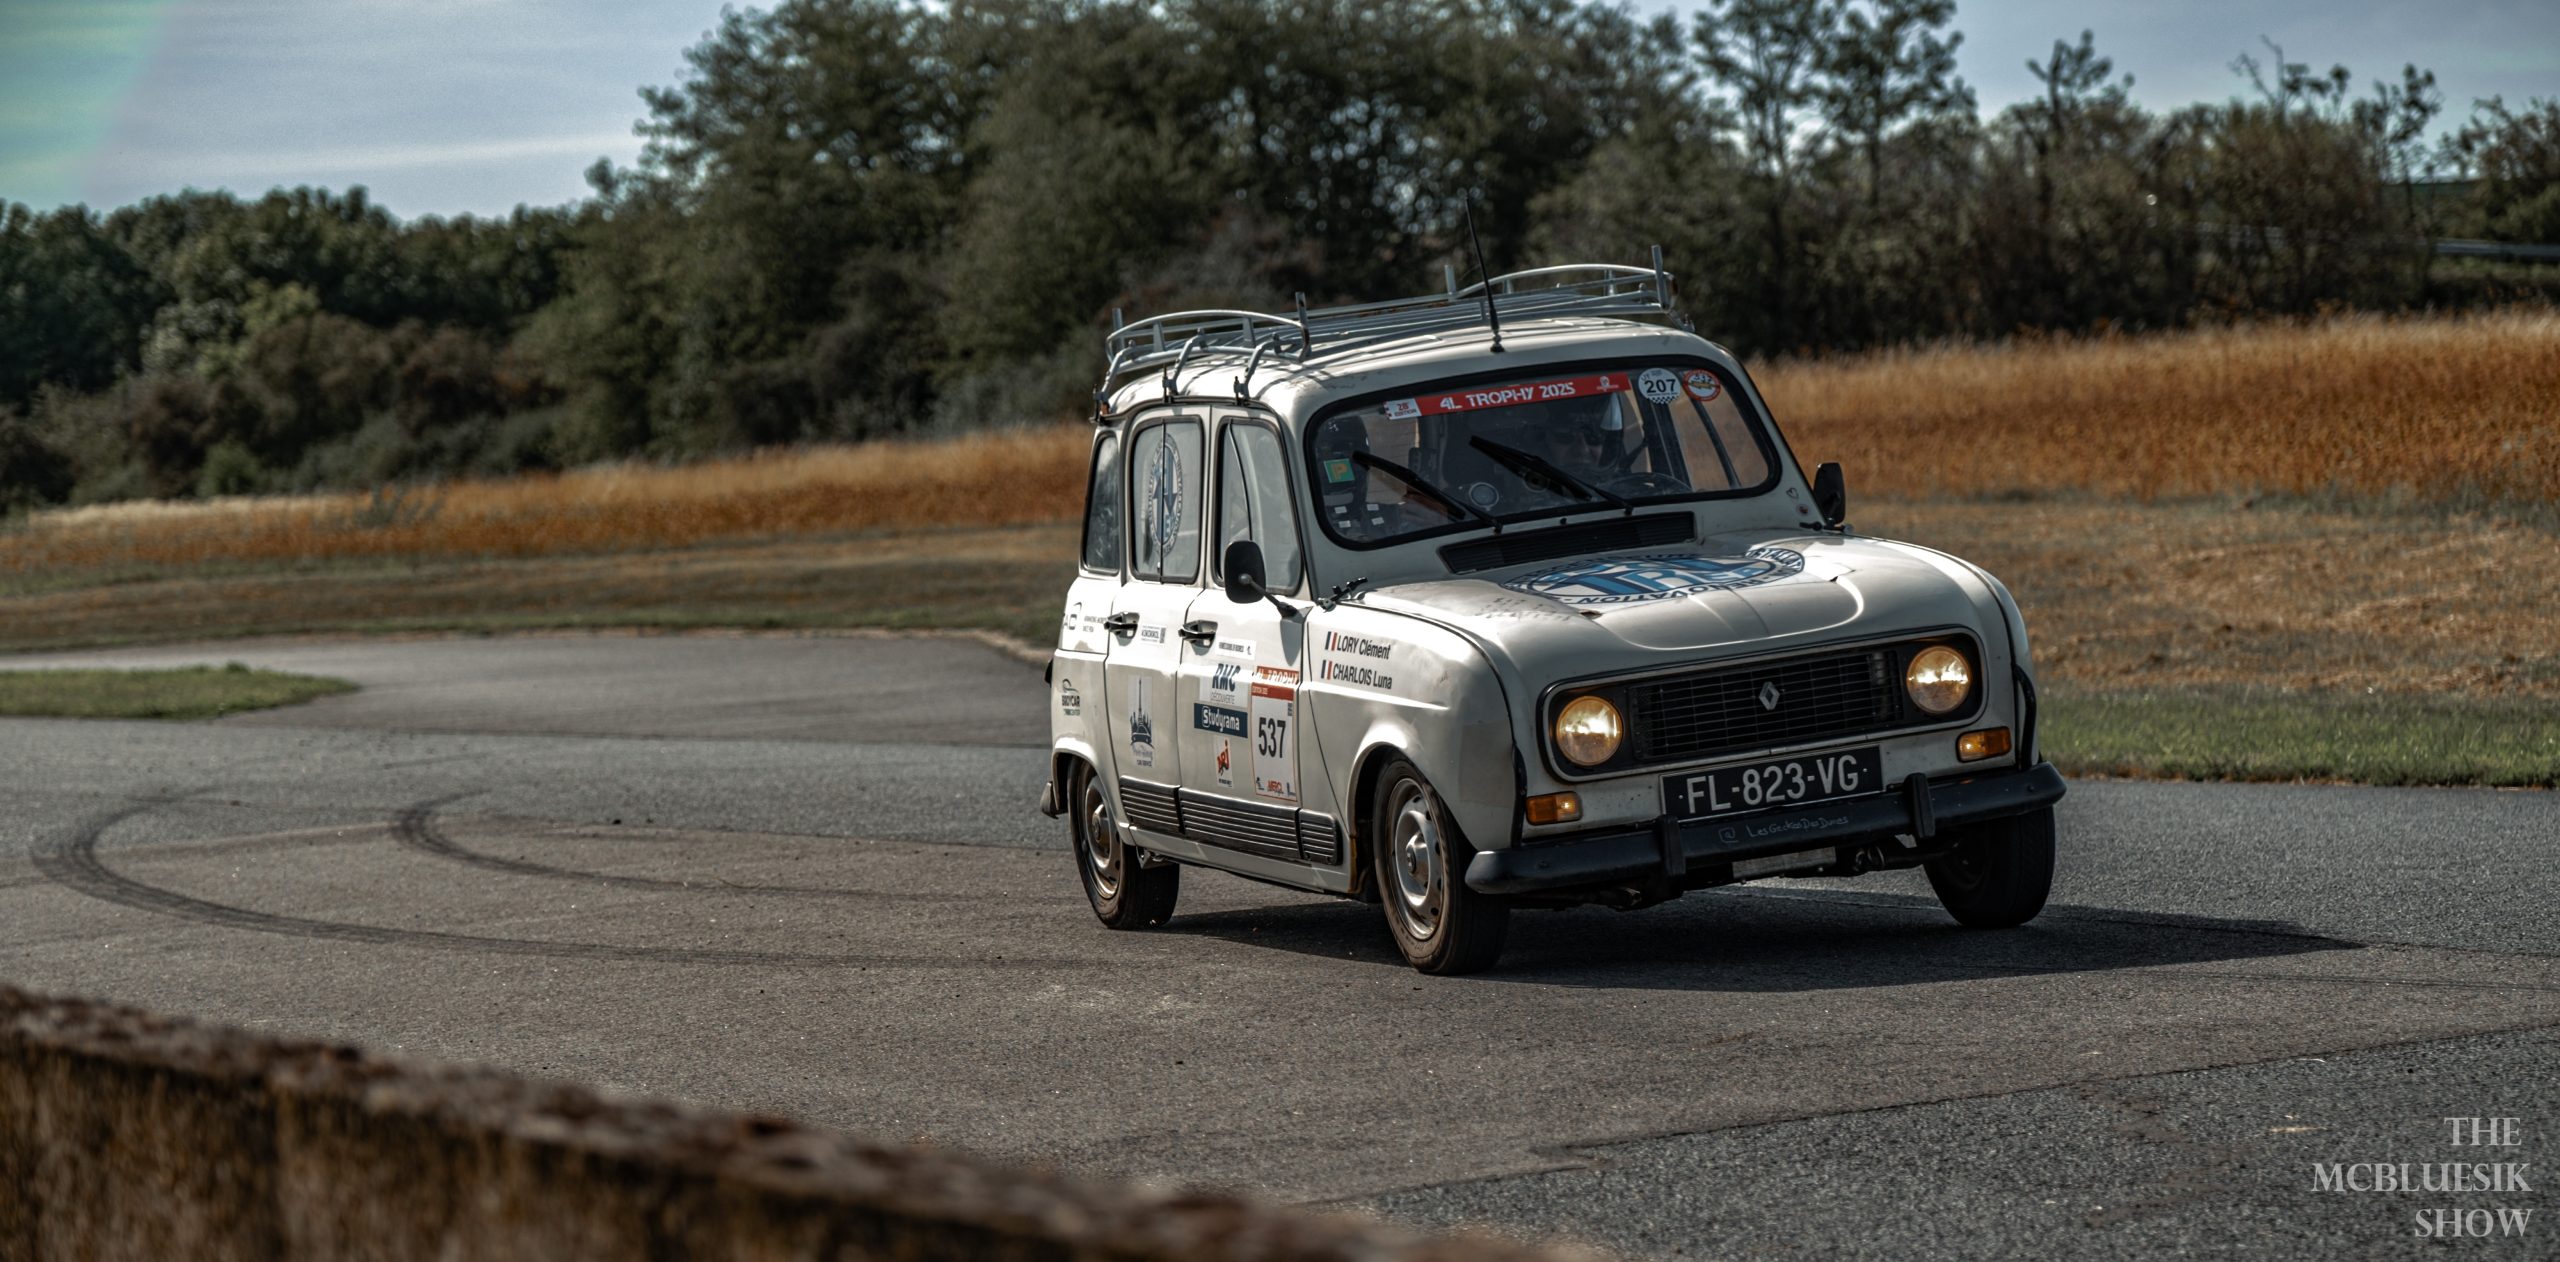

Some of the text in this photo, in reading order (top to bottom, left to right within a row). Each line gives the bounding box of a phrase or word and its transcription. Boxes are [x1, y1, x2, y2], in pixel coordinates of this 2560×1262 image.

[1440, 396, 1463, 410] 4L
[1465, 386, 1534, 408] TROPHY
[1539, 381, 1577, 399] 2025
[1644, 378, 1677, 394] 207
[1336, 634, 1391, 661] LORY Clément
[1211, 662, 1241, 693] RMC
[1332, 662, 1393, 690] CHARLOIS Luna
[1202, 705, 1240, 733] Studyrama
[1258, 716, 1287, 759] 537
[1686, 754, 1860, 815] FL-823-VG
